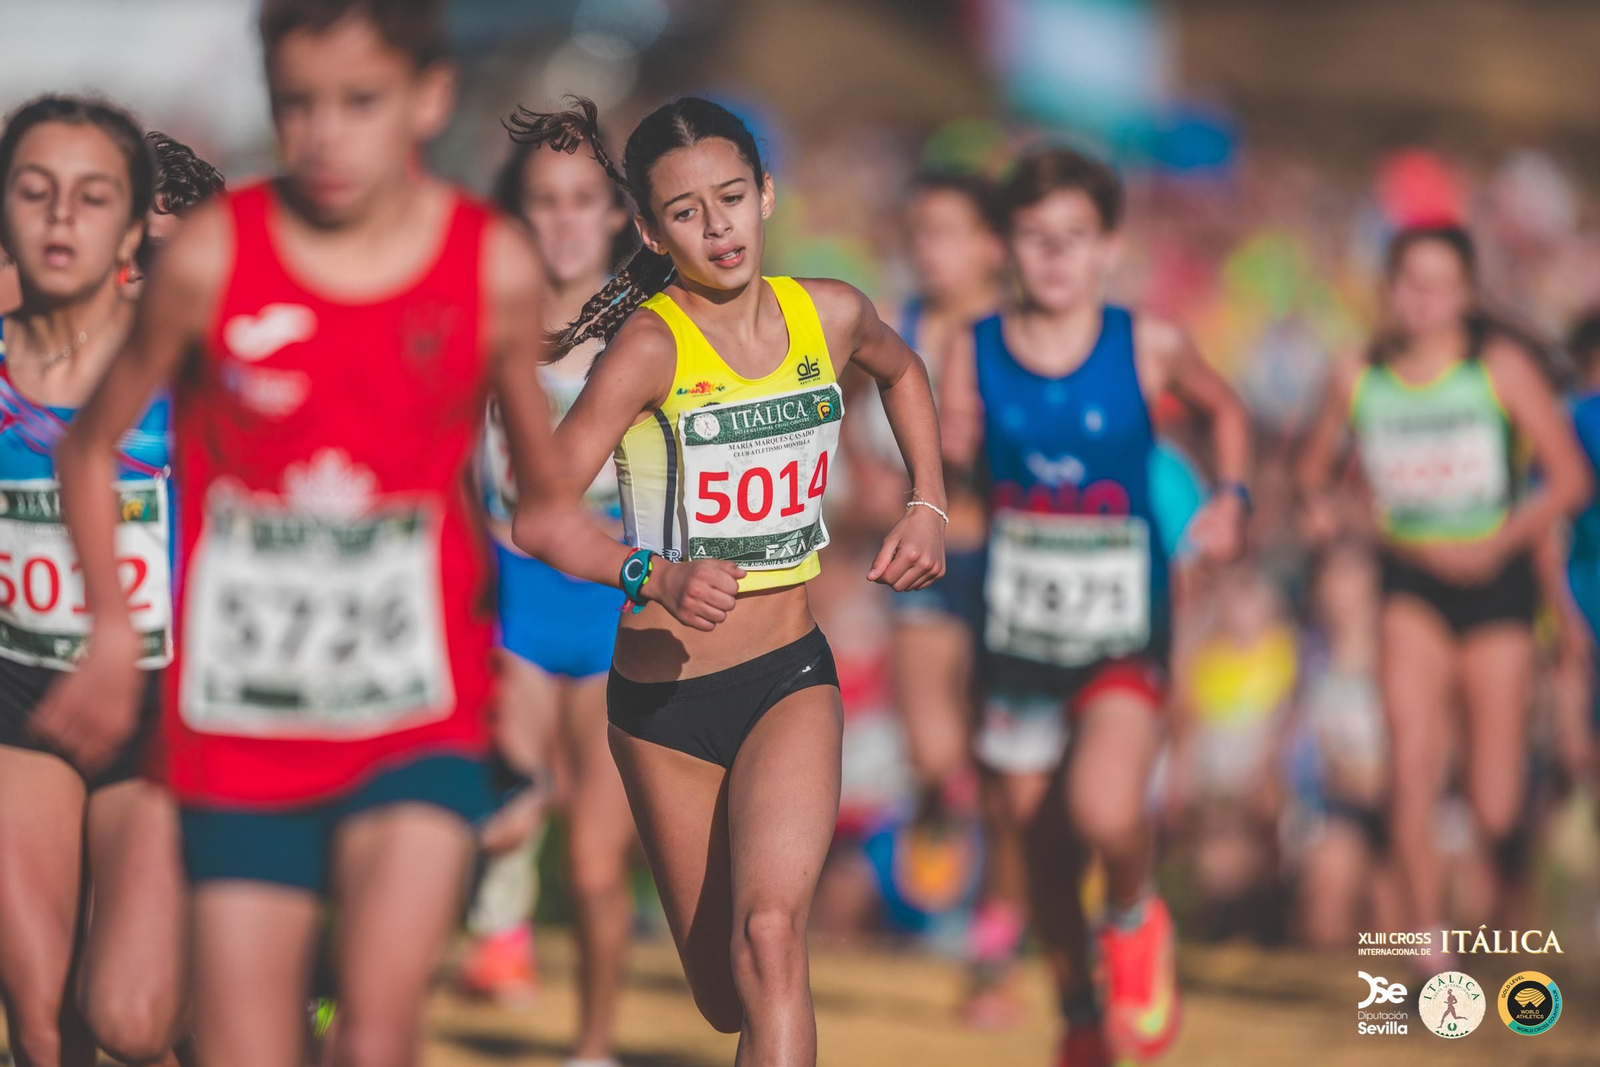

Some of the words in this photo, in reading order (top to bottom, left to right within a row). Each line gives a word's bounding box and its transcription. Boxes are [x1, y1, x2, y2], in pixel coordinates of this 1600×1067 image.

[730, 400, 808, 430] ITÁLICA
[789, 429, 815, 441] CASADO
[733, 450, 750, 458] CLUB
[751, 445, 783, 455] ATLETISMO
[783, 439, 811, 450] MONTILLA
[695, 450, 828, 524] 5014
